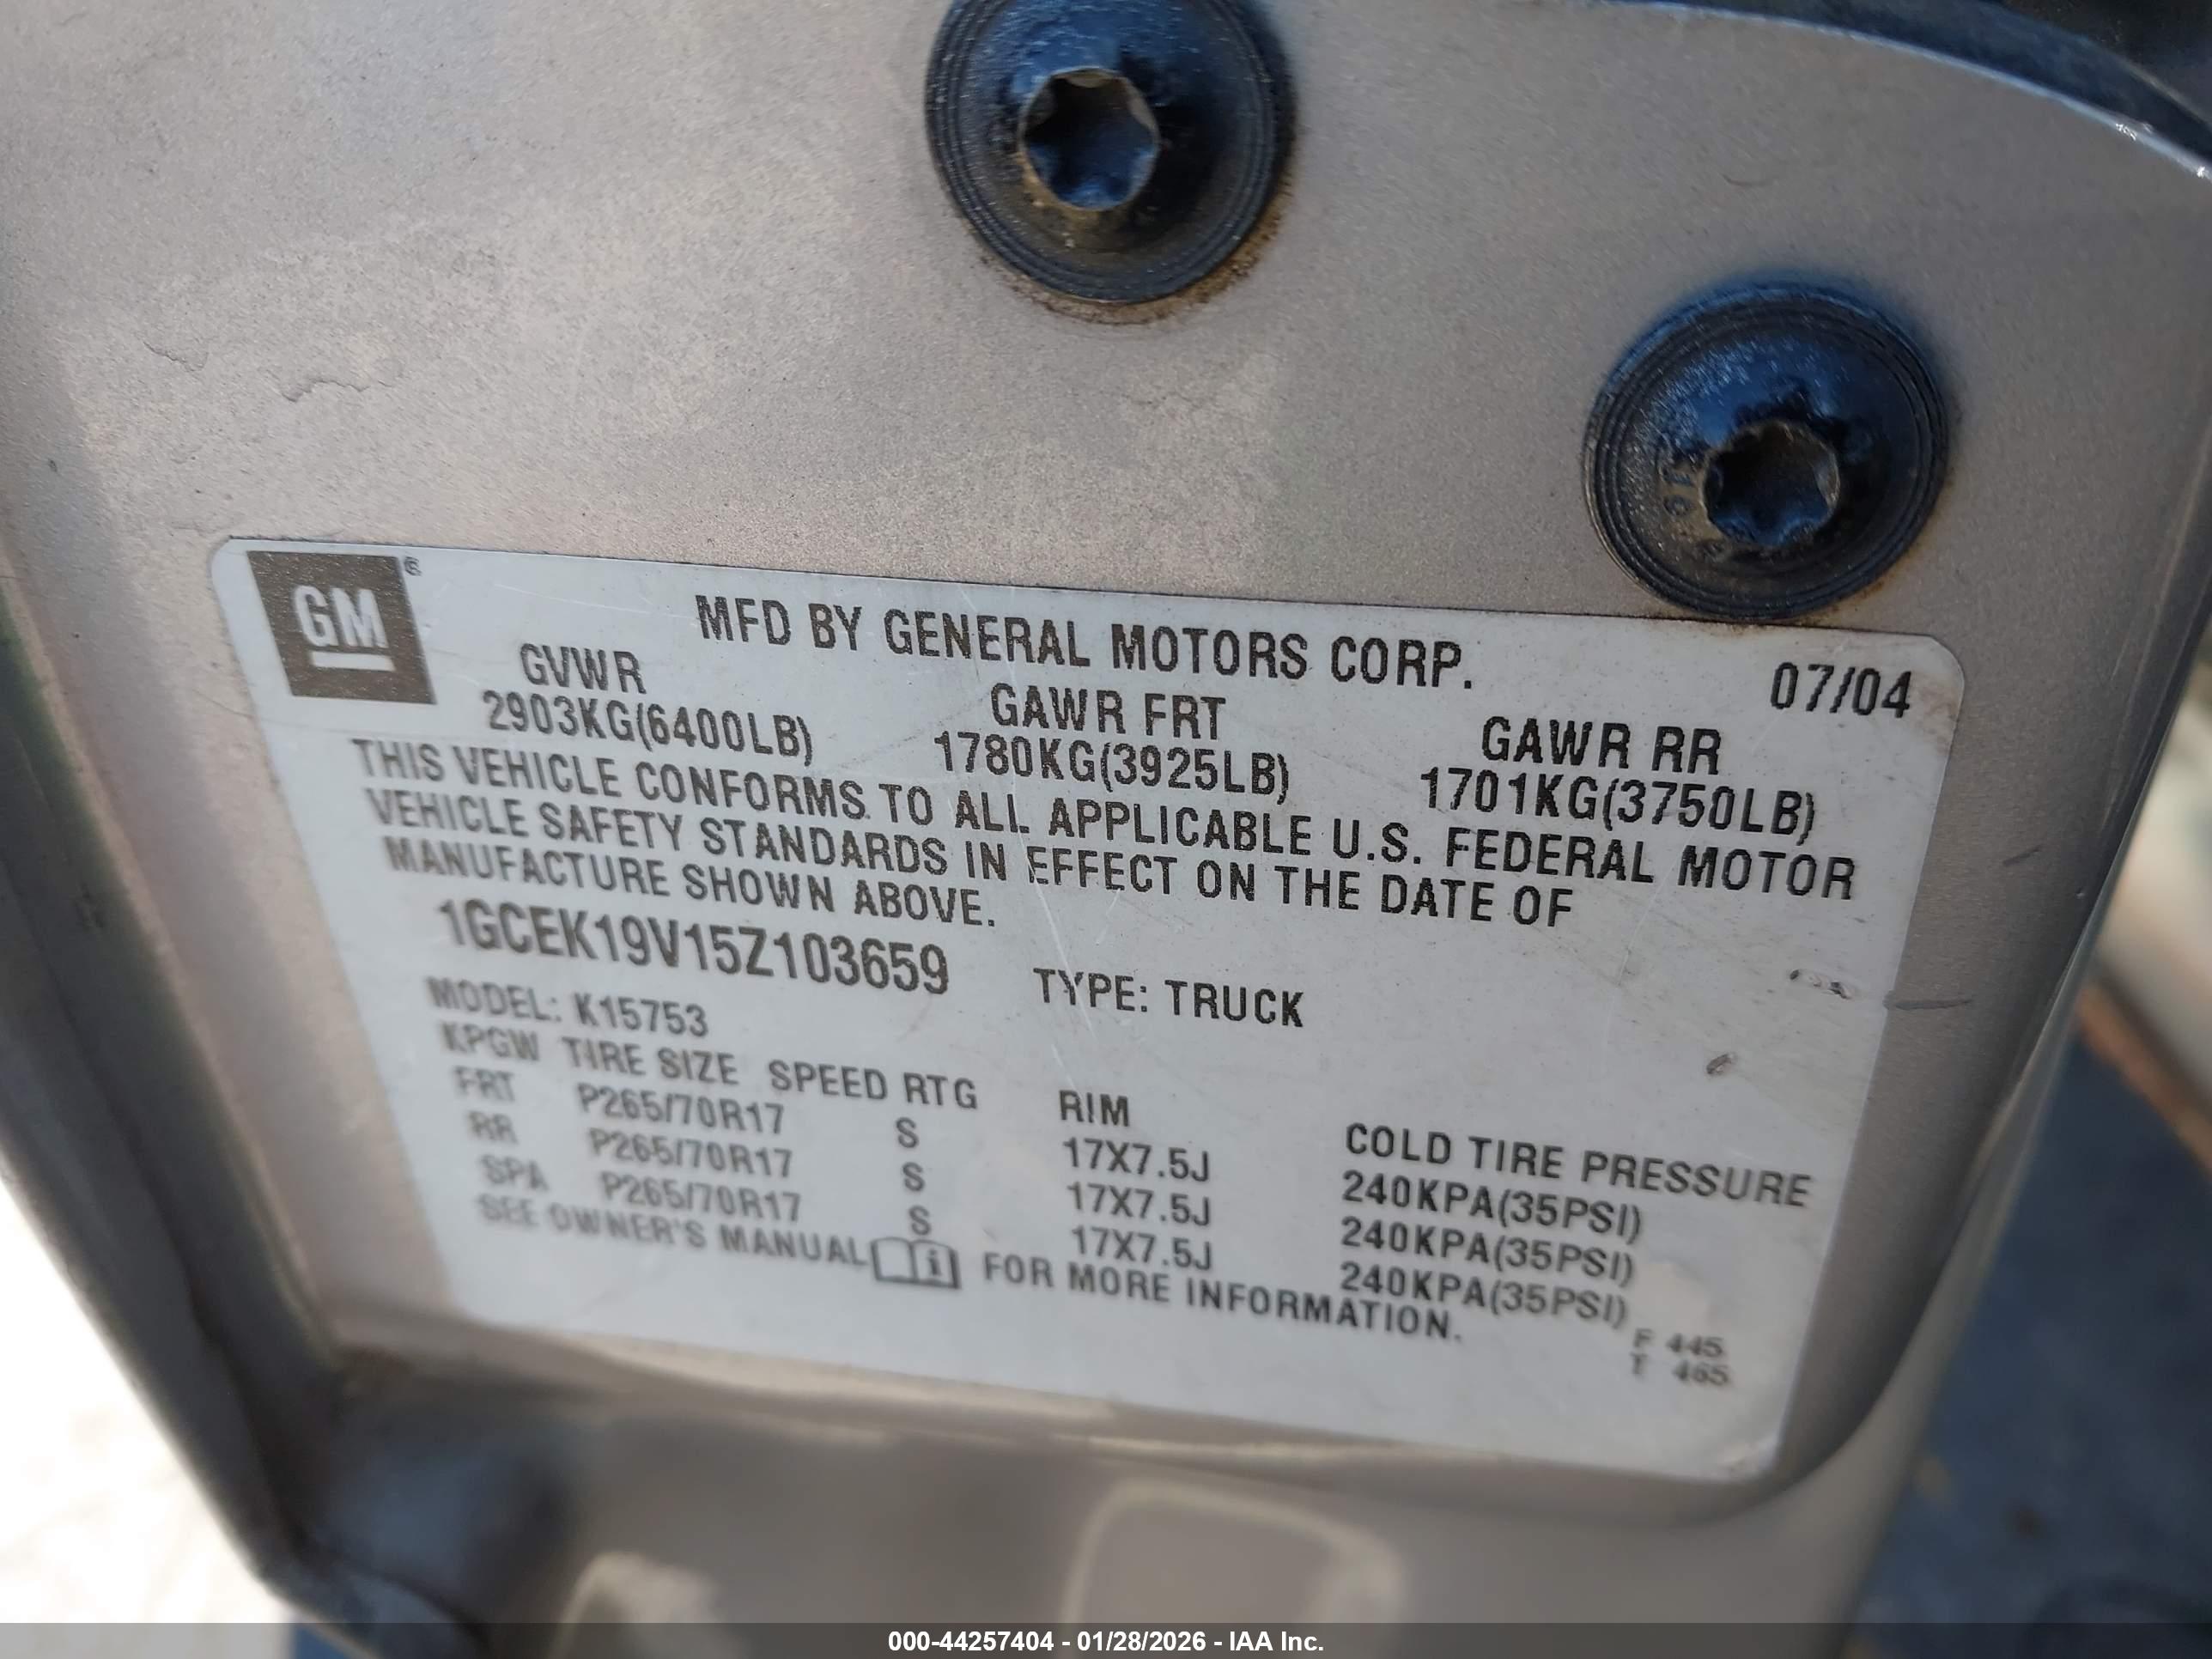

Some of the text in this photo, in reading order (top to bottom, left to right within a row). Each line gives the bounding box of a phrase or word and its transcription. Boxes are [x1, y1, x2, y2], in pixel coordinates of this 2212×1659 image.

[294, 585, 390, 649] GM
[694, 593, 1474, 690] MFD BY GENERAL MOTORS CORP.
[517, 642, 648, 696] GVWR
[1769, 660, 1913, 720] 07/04
[480, 690, 814, 768] 2903KG(6400LB)
[989, 681, 1227, 741] GAWR FRT
[1480, 714, 1723, 776] GAWR RR
[933, 730, 1291, 805] 1780KG(3925LB)
[1419, 765, 1817, 845] 1701KG(3750LB)
[349, 737, 1858, 902] THIS VEHICLE CONFORMS TO ALL APPLICABLE U.S. FEDERAL MOTOR
[363, 787, 1575, 928] VEHICLE SAFETY STANDARDS IN EFFECT ON THE DATE OF
[381, 835, 996, 928] MANUFACTURE SHOWN ABOVE.
[436, 898, 951, 996] 1GCEK19V15Z103659
[424, 975, 710, 1039] MODEL: K15753
[1031, 966, 1305, 1029] TYPE: TRUCK
[440, 1022, 1813, 1208] KPGW TIRE SIZE SPEED RTG RIM COLD TIRE PRESSURE
[453, 1066, 1644, 1243] FRT P265/70R17 S 17X7.5J 240KPA(35PSI)
[467, 1110, 1635, 1288] RR P265/70R17 S 17X7.5J 240KPA(35PSI)
[476, 1194, 1462, 1341] SEE OWNER'S MANUAL FOR MORE INFORMATION.
[479, 1154, 1629, 1330] SPA P265/70R17 S 17X7.5J 240KPA(35PSI)
[1665, 1332, 1724, 1358] 445
